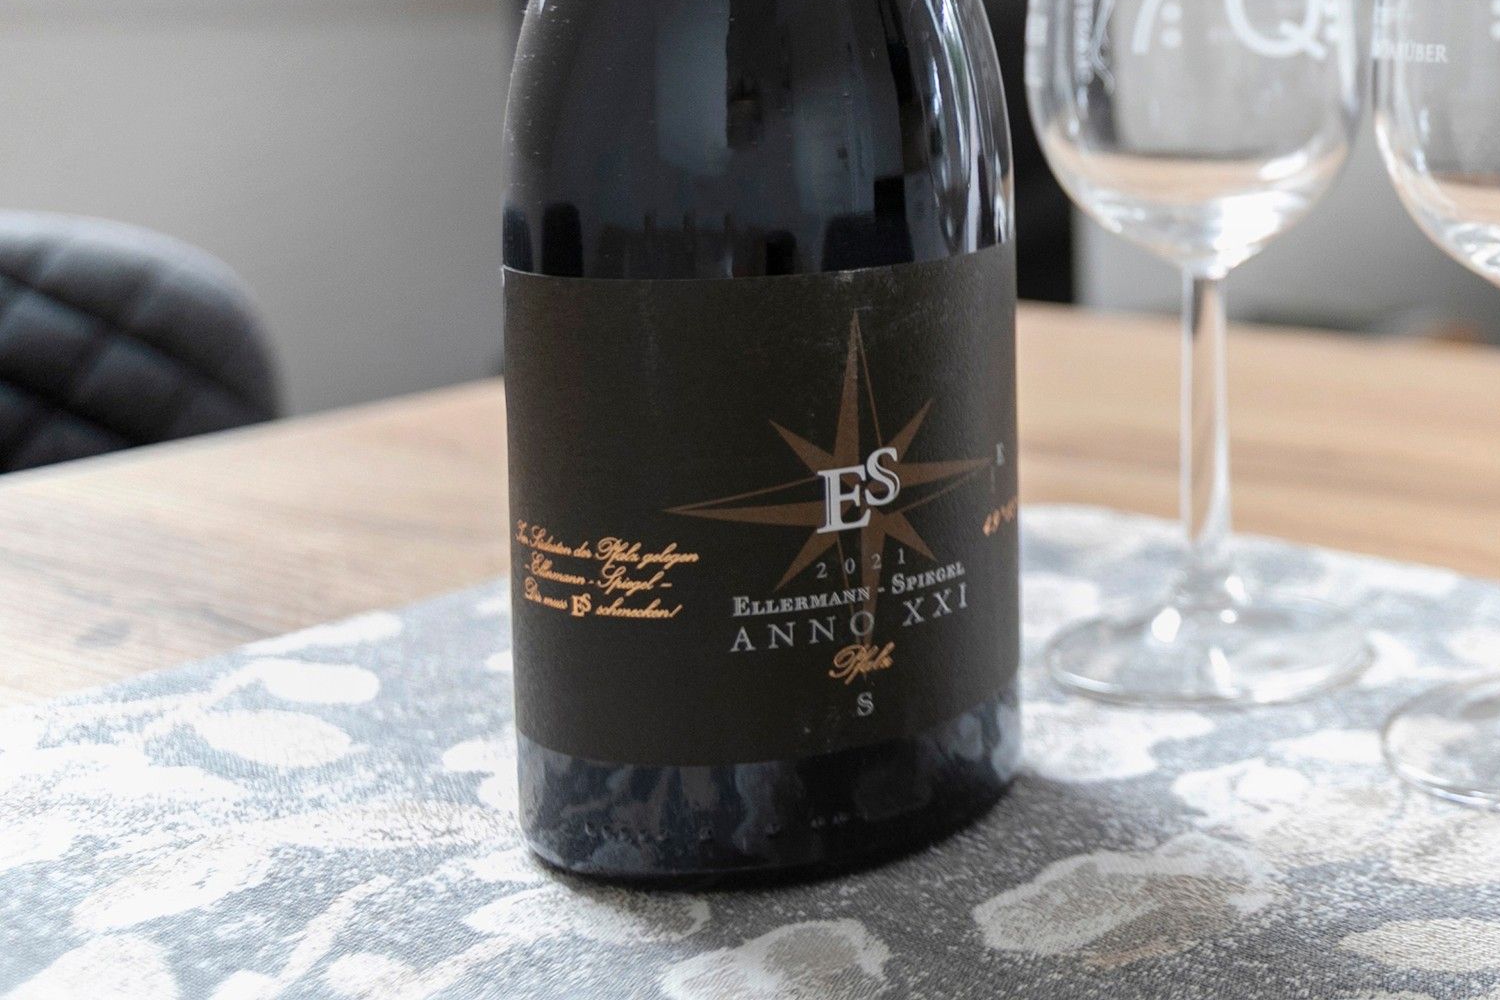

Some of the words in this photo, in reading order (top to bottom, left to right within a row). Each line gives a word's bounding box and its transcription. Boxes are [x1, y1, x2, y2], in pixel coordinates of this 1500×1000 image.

[816, 446, 900, 534] ES
[595, 536, 642, 566] Pfalz
[637, 542, 700, 570] gelegen
[597, 564, 666, 597] Spiegel
[732, 585, 871, 617] ELLERMANN
[891, 562, 966, 595] SPIEGEL
[570, 592, 593, 618] ES
[595, 597, 684, 619] schmecken!
[730, 610, 875, 652] ANNO
[902, 582, 969, 627] XXI
[828, 641, 896, 686] Pfalz
[856, 691, 875, 717] S
